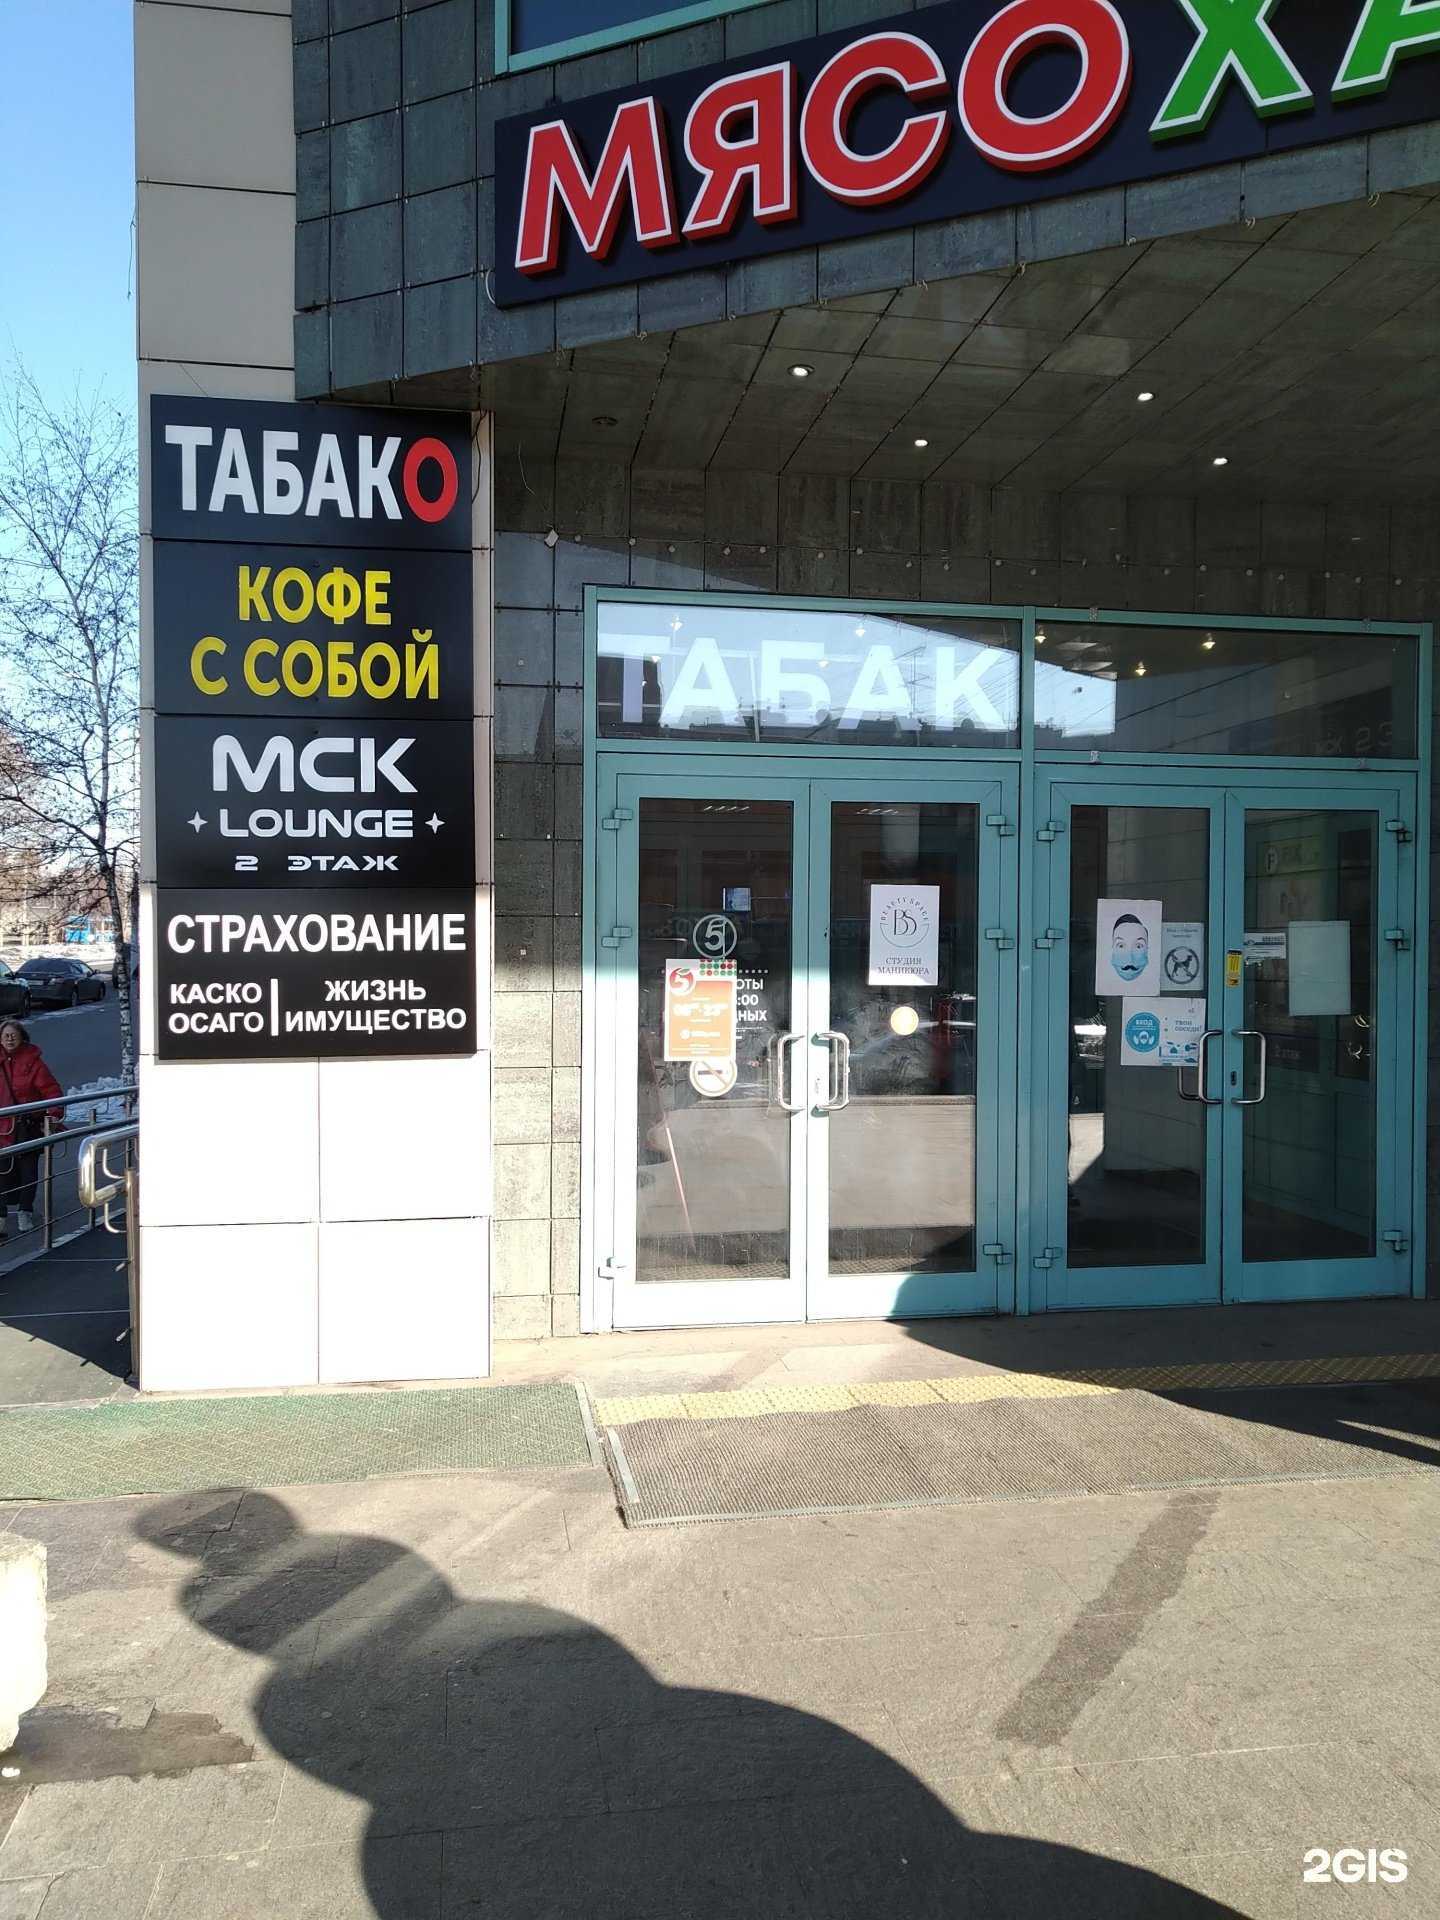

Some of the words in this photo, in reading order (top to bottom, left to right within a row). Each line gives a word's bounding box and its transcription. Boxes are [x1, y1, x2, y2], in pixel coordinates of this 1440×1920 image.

[165, 424, 459, 523] ТАБАКО
[238, 565, 392, 625] КОФЕ
[190, 636, 229, 696] С
[243, 629, 439, 700] СОБОЙ
[598, 633, 1016, 733] ТАБАК
[212, 734, 418, 793] МСК
[219, 808, 413, 838] LOUNGE
[234, 855, 259, 871] 2
[288, 855, 400, 871] ЭТАЖ
[167, 914, 467, 954] СТРАХОВАНИЕ
[169, 982, 263, 1004] КАСКО
[324, 979, 427, 1002] ЖИЗНЬ
[168, 1011, 264, 1034] ОСАГО
[285, 1008, 467, 1034] ИМУЩЕСТВО
